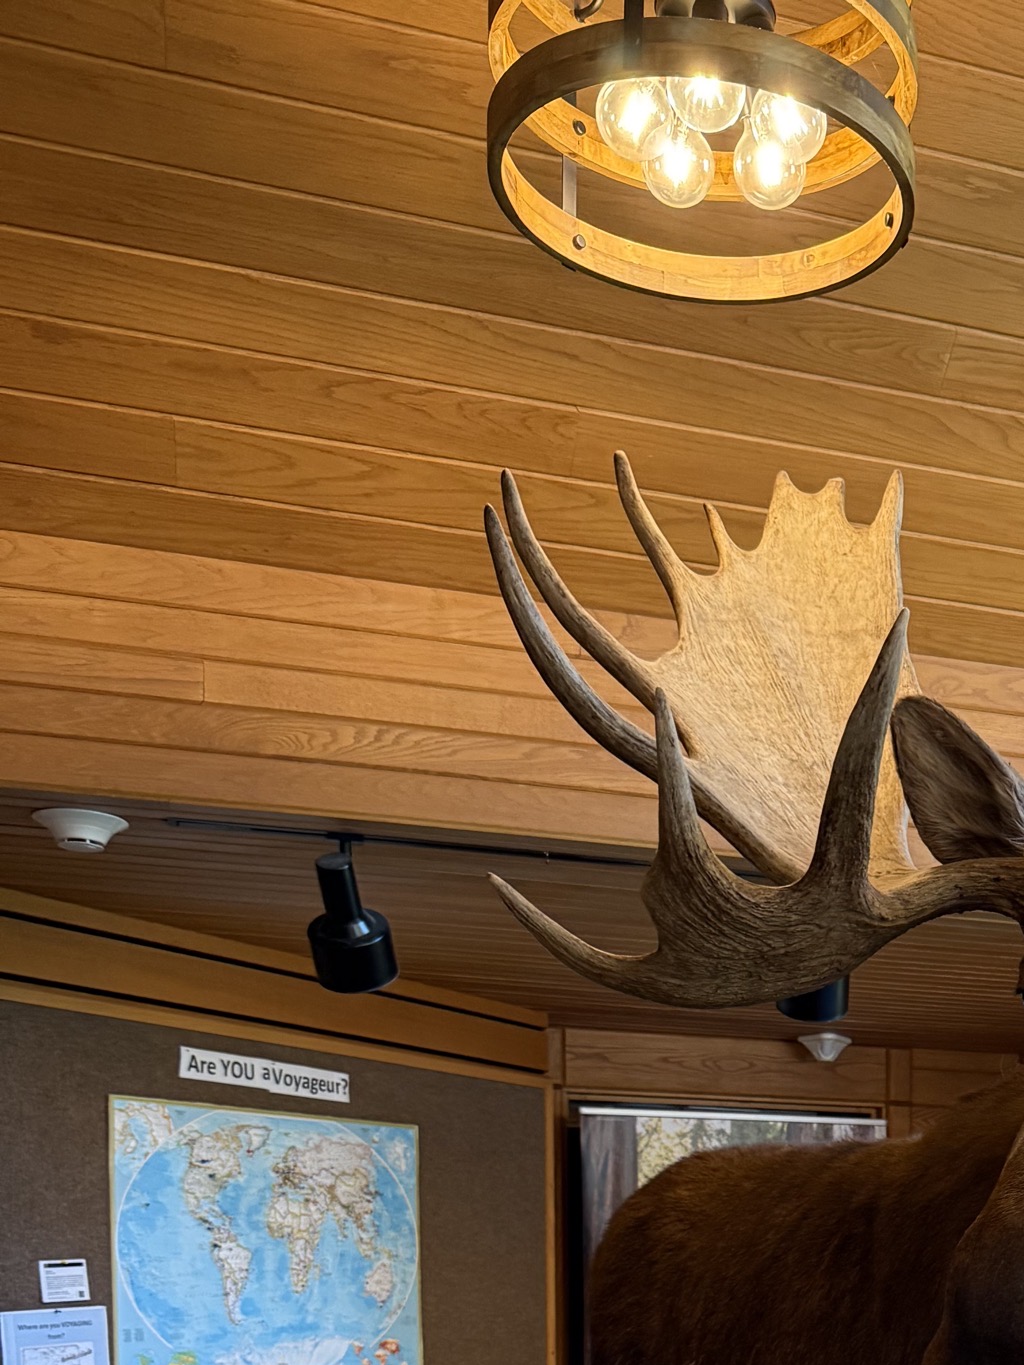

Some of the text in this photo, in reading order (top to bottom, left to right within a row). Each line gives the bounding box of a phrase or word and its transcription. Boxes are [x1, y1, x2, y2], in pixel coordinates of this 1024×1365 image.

[187, 1054, 348, 1095] Are YOU a Voyageur?
